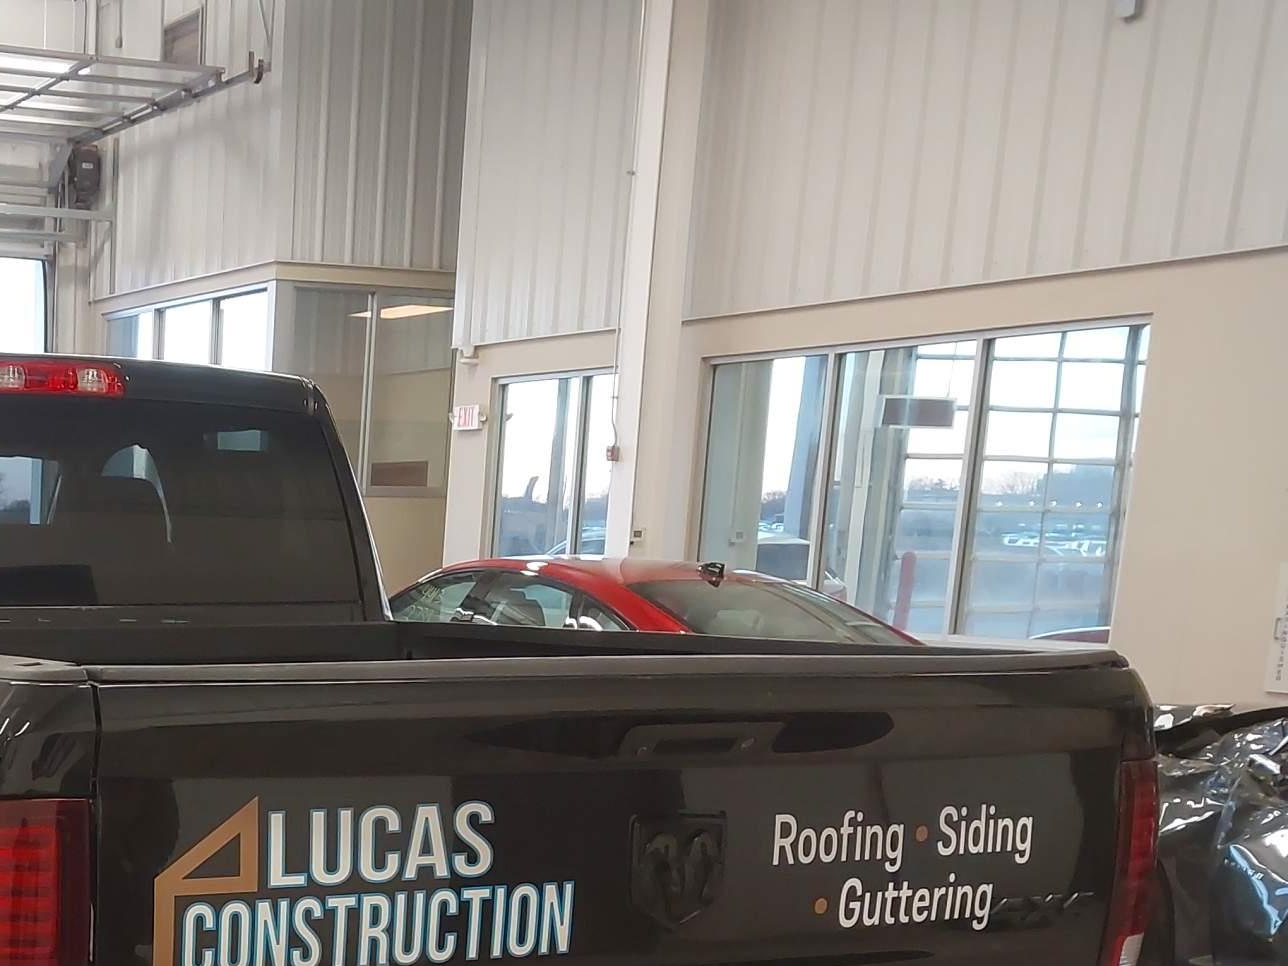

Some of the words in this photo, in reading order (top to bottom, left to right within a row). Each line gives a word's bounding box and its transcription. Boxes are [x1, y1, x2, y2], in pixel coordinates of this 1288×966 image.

[267, 800, 496, 888] LUCAS
[771, 810, 905, 873] Roofing
[937, 804, 1033, 864] Siding
[838, 873, 993, 931] Guttering
